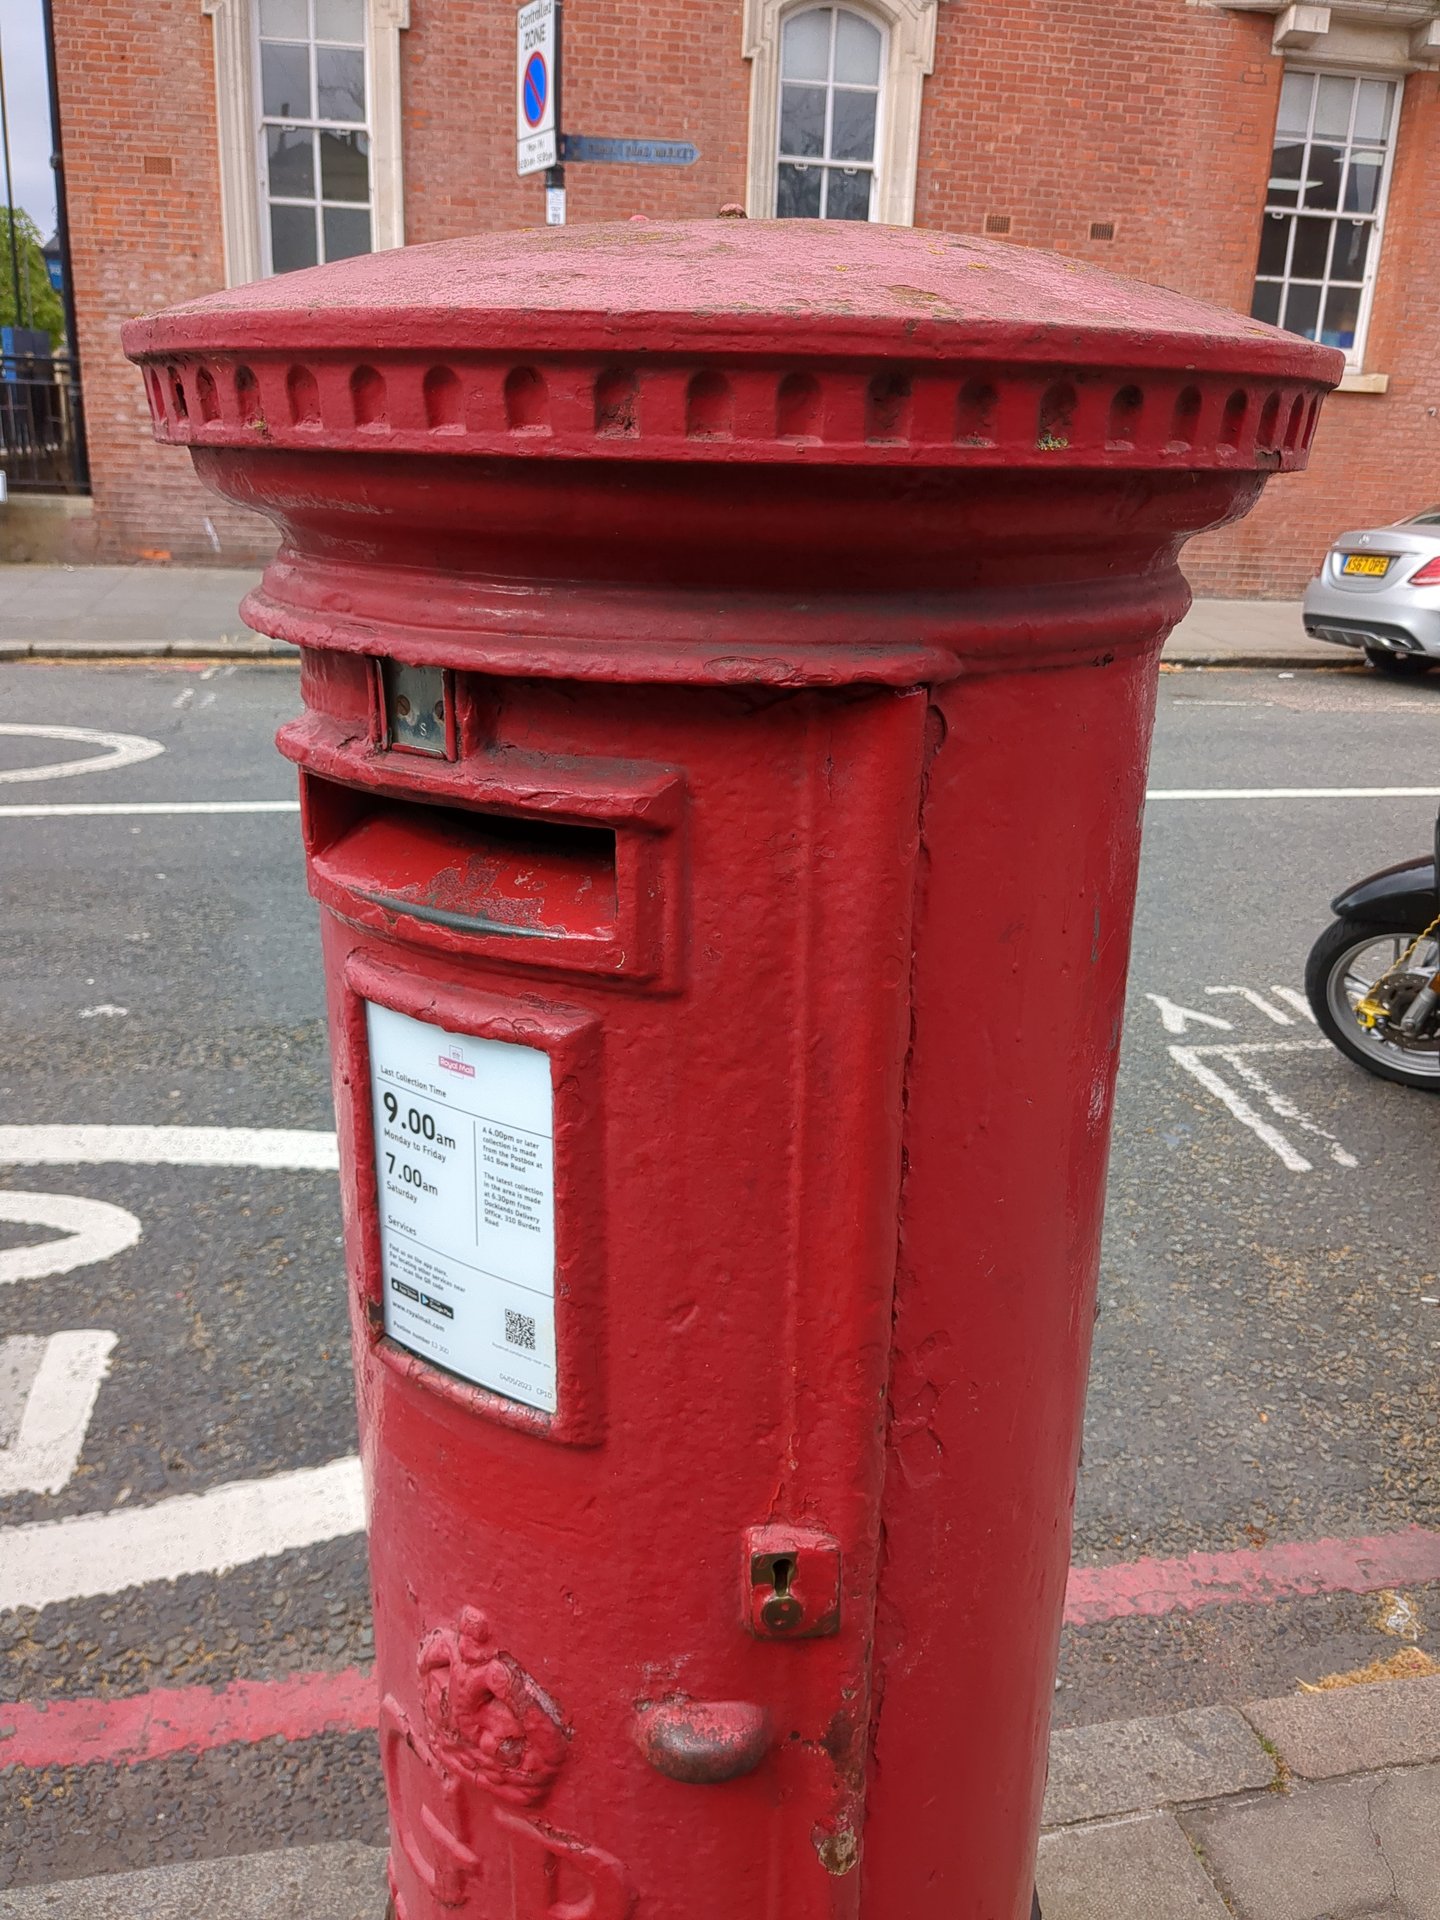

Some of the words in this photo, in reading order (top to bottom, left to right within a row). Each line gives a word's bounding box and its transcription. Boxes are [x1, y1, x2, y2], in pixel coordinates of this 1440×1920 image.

[520, 2, 552, 29] Controlled
[524, 24, 546, 50] ZONE
[420, 722, 428, 736] S
[440, 1056, 458, 1071] Royal
[458, 1062, 474, 1076] Mail
[380, 1064, 394, 1077] Last
[395, 1071, 427, 1090] Collection
[428, 1084, 446, 1098] Time
[383, 1091, 455, 1149] 9.00am
[383, 1127, 411, 1148] Monday
[412, 1141, 420, 1151] to
[422, 1144, 446, 1163] Friday
[482, 1137, 511, 1150] collection
[519, 1148, 536, 1158] made
[488, 1128, 514, 1142] 4.00pm
[524, 1139, 539, 1149] later
[482, 1144, 497, 1154] from
[510, 1153, 534, 1166] Postbox
[496, 1158, 508, 1167] Bow
[510, 1162, 526, 1173] Road
[385, 1151, 437, 1195] 7.00am
[484, 1171, 494, 1180] The
[496, 1176, 513, 1186] latest
[514, 1183, 543, 1196] collection
[386, 1180, 417, 1204] Saturday
[491, 1192, 515, 1206] 6.30pm
[517, 1201, 532, 1211] from
[502, 1188, 515, 1196] area
[524, 1195, 541, 1204] made
[484, 1199, 513, 1214] Docklands
[515, 1209, 539, 1224] Delivery
[484, 1207, 502, 1220] Office,
[504, 1214, 516, 1224] 310
[517, 1219, 540, 1232] Burdett
[484, 1216, 499, 1227] Road
[388, 1214, 416, 1236] Services
